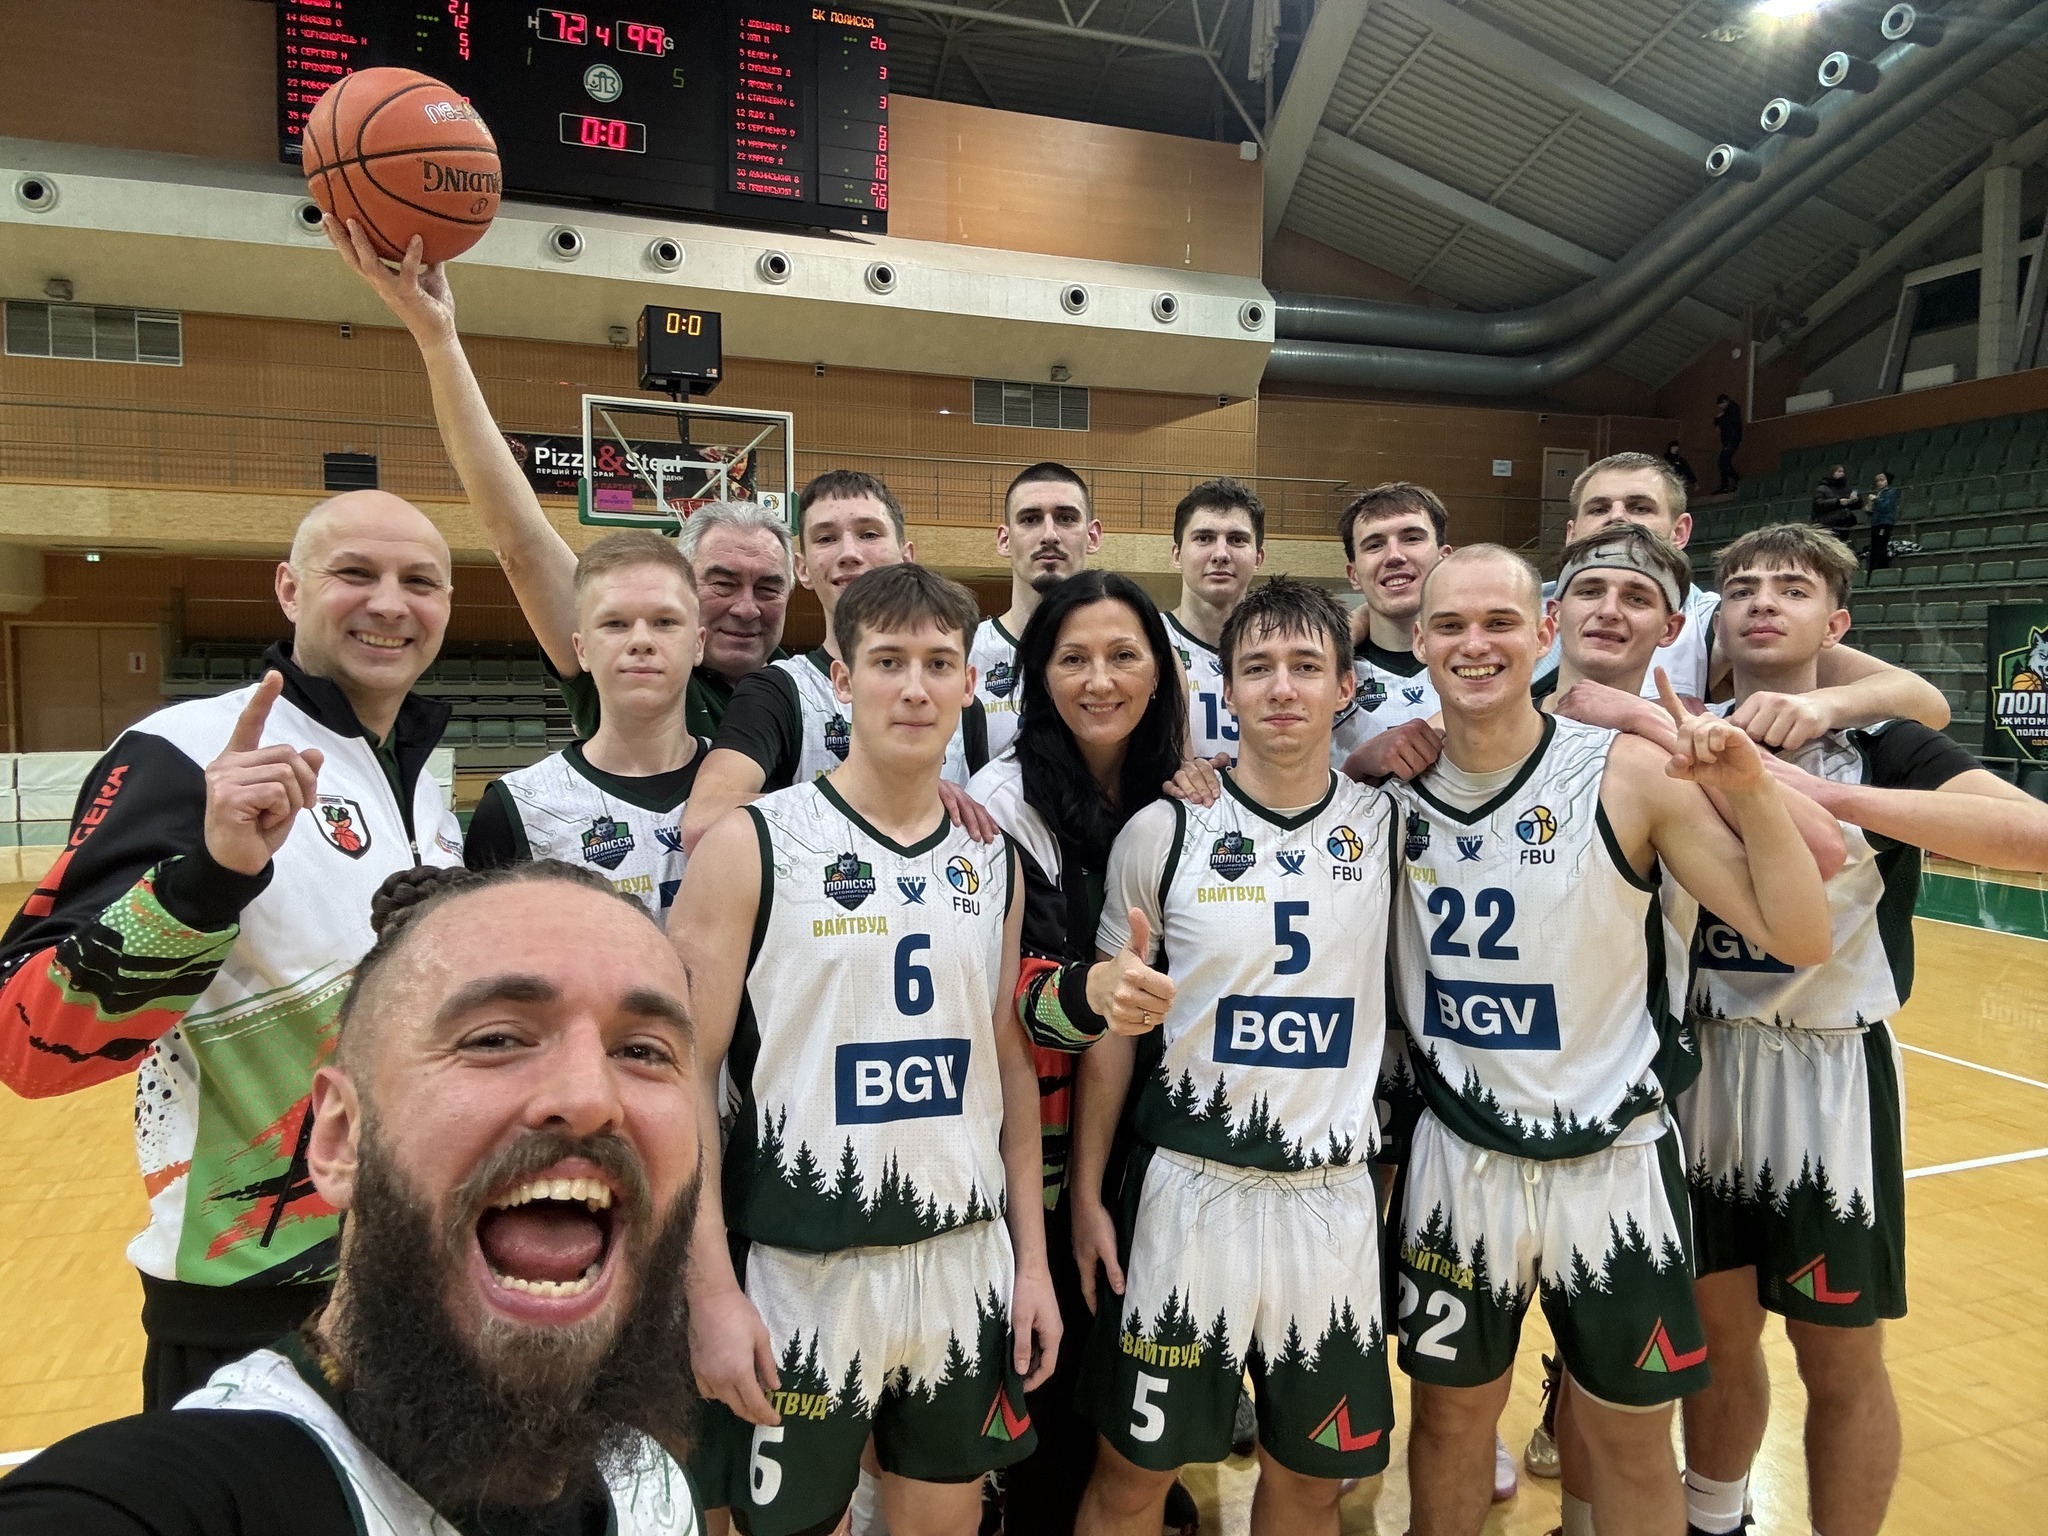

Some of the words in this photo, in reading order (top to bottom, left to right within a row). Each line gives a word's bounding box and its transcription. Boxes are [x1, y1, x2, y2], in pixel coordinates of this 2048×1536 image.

[454, 15, 469, 29] 12
[527, 16, 540, 29] H
[551, 12, 586, 43] 72
[459, 33, 469, 47] 5
[595, 25, 610, 47] 4
[627, 25, 664, 54] 99
[663, 37, 675, 50] G
[869, 35, 887, 51] 26
[459, 48, 470, 61] 4
[879, 66, 888, 80] 3
[879, 96, 888, 110] 3
[581, 117, 627, 148] 0:0
[878, 125, 887, 138] 5
[875, 154, 887, 167] 12
[423, 160, 502, 195] PALDING
[870, 182, 888, 196] 22
[666, 312, 702, 336] 0:0
[1997, 692, 2048, 715] ПОЛ
[2000, 717, 2048, 725] ЖИТОМ
[585, 836, 634, 857] ПОЛІССЯ
[1211, 853, 1255, 864] ПОЛІССЯ
[1519, 849, 1555, 865] FBU
[1332, 866, 1363, 881] FBU
[1406, 865, 1438, 885] ТВУД
[612, 874, 654, 894] ТВУД
[826, 879, 875, 893] ПОЛІССЯ
[1197, 883, 1267, 904] ВАЙТВУД
[953, 896, 980, 916] FBU
[812, 914, 889, 938] ВАЙТВУД
[1427, 886, 1519, 961] 22
[1273, 900, 1311, 976] 5
[894, 933, 934, 1017] 6
[1436, 989, 1537, 1036] BGV
[1230, 1009, 1341, 1054] BGV
[1122, 1331, 1202, 1369] ВАЙТВУД
[768, 1389, 830, 1420] ТВУД
[1129, 1370, 1170, 1442] 5
[750, 1425, 785, 1506] 6
